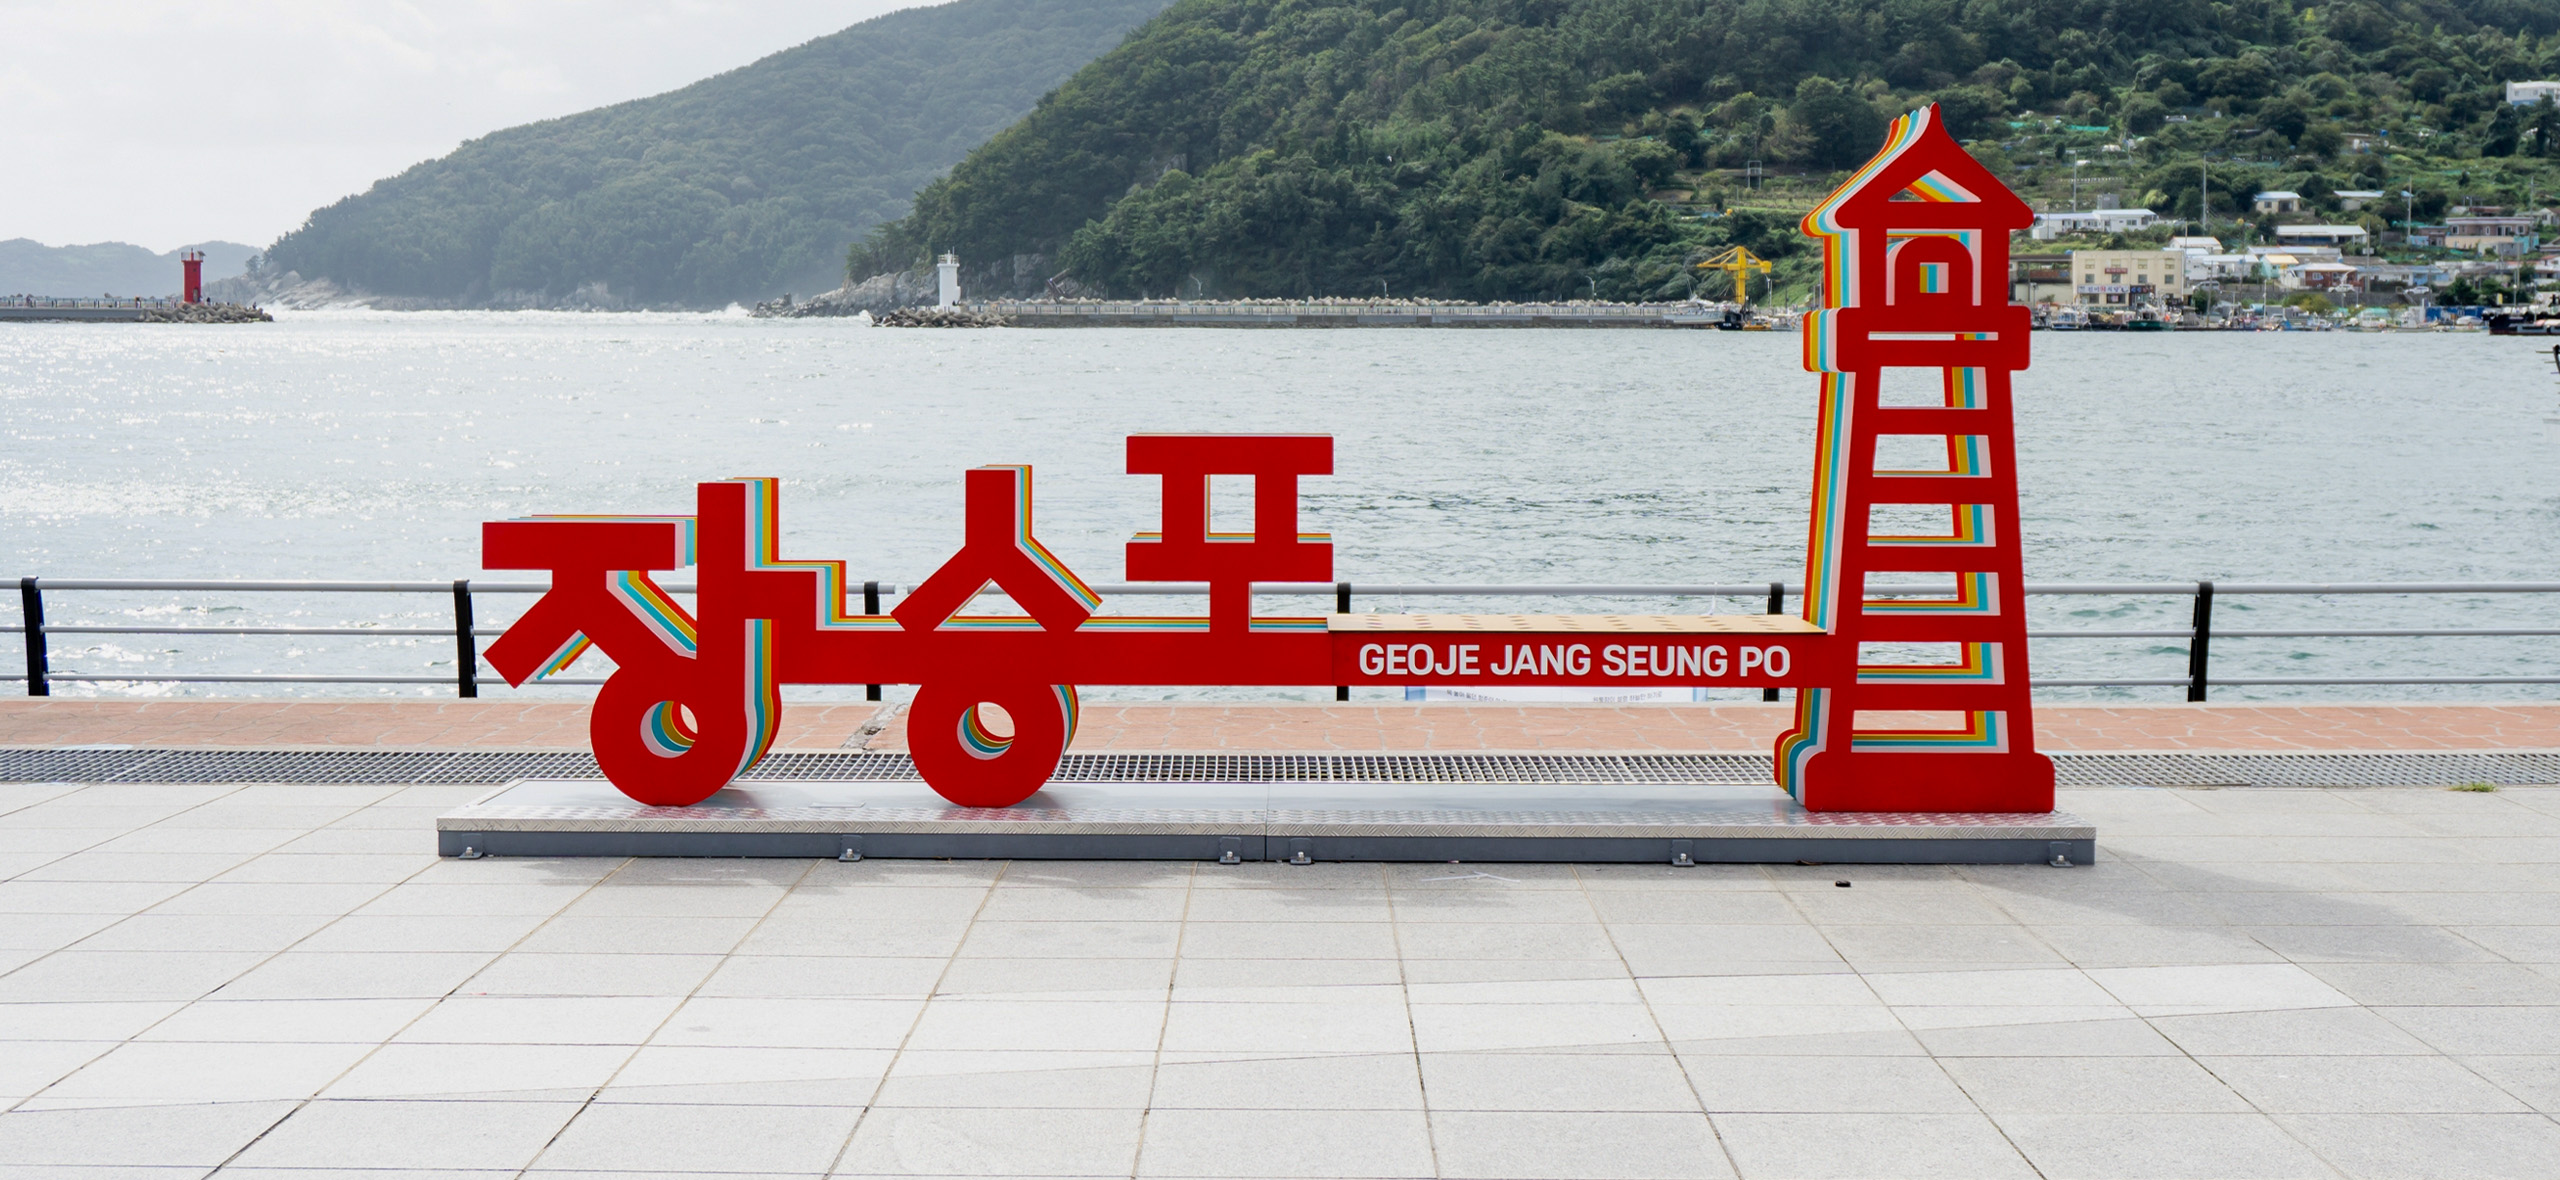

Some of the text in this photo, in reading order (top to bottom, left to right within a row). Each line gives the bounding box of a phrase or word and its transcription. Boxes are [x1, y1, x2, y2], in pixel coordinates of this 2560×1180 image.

[482, 432, 1334, 807] 장승포
[1359, 643, 1790, 676] GEOJE JANG SEUNG PO
